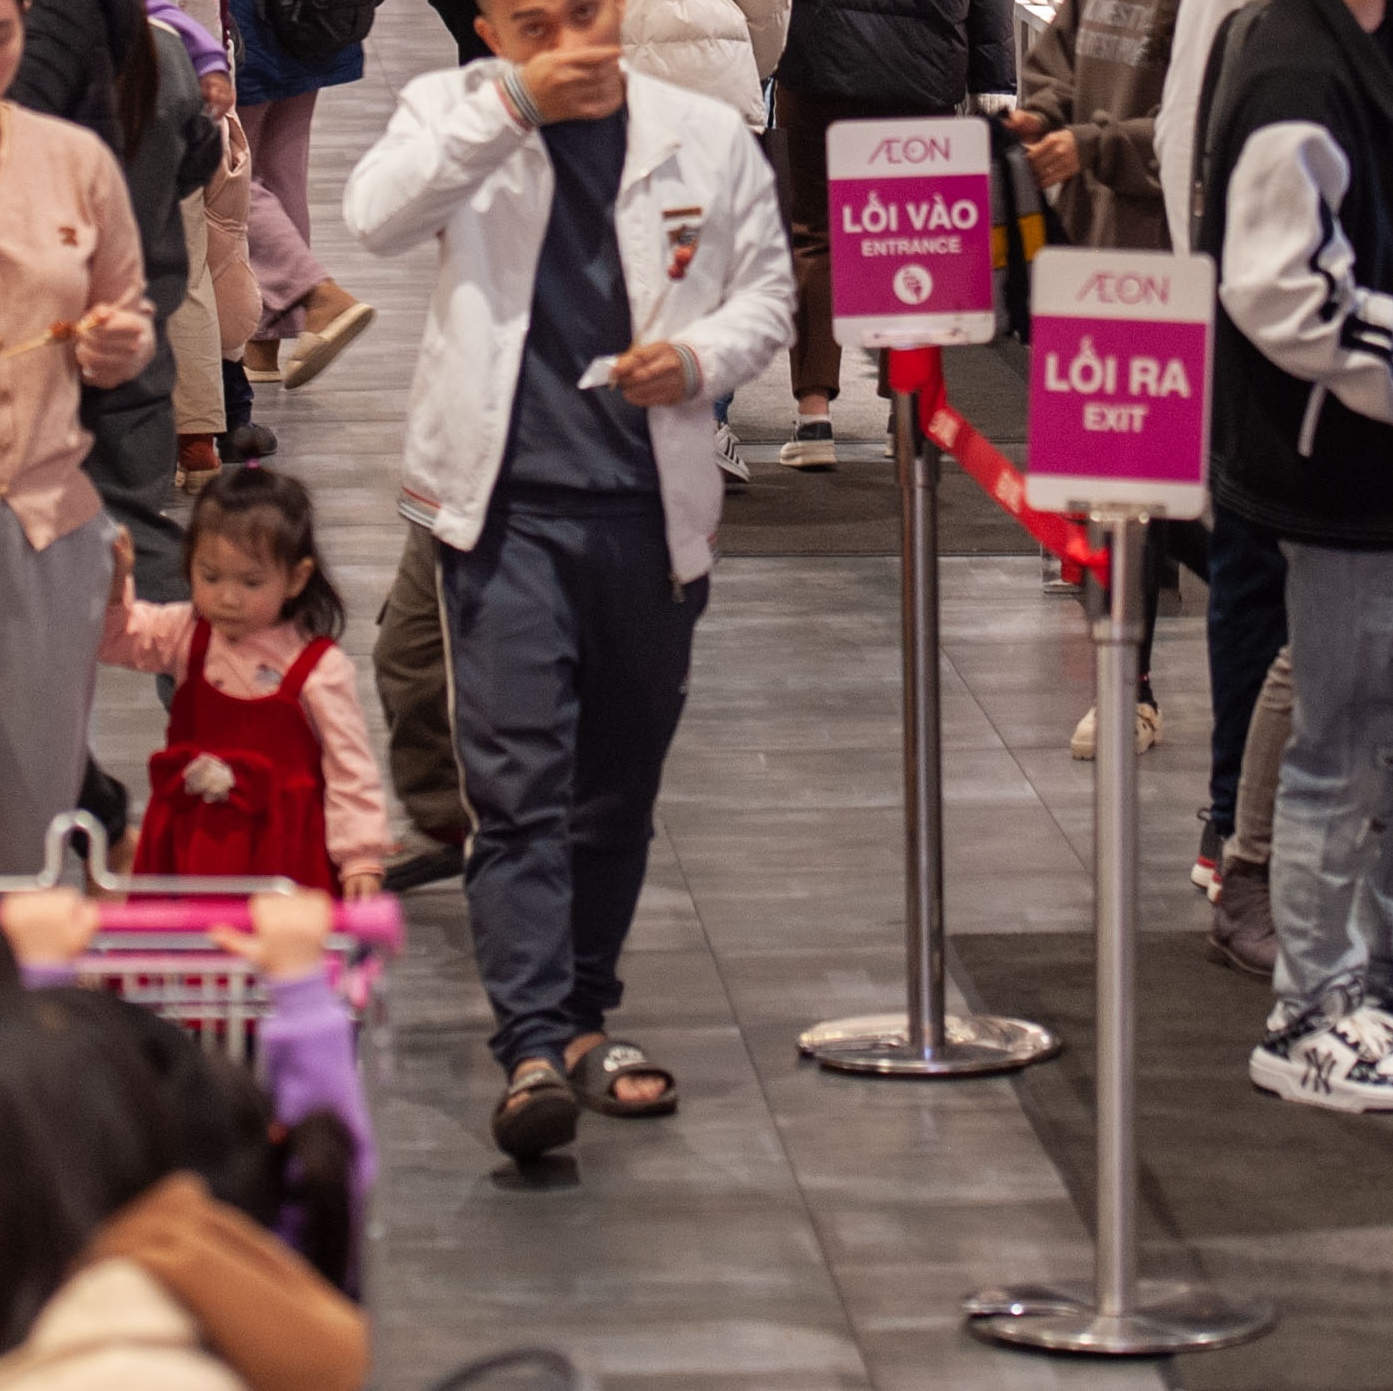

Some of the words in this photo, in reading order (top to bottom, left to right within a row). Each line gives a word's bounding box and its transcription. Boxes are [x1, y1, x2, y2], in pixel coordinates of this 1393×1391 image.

[842, 189, 899, 234] LỐI
[906, 191, 979, 231] VÀO
[861, 236, 962, 258] ENTRANCE
[1043, 334, 1118, 395] LỐI
[1129, 357, 1191, 399] RA
[1082, 402, 1151, 433] EXIT
